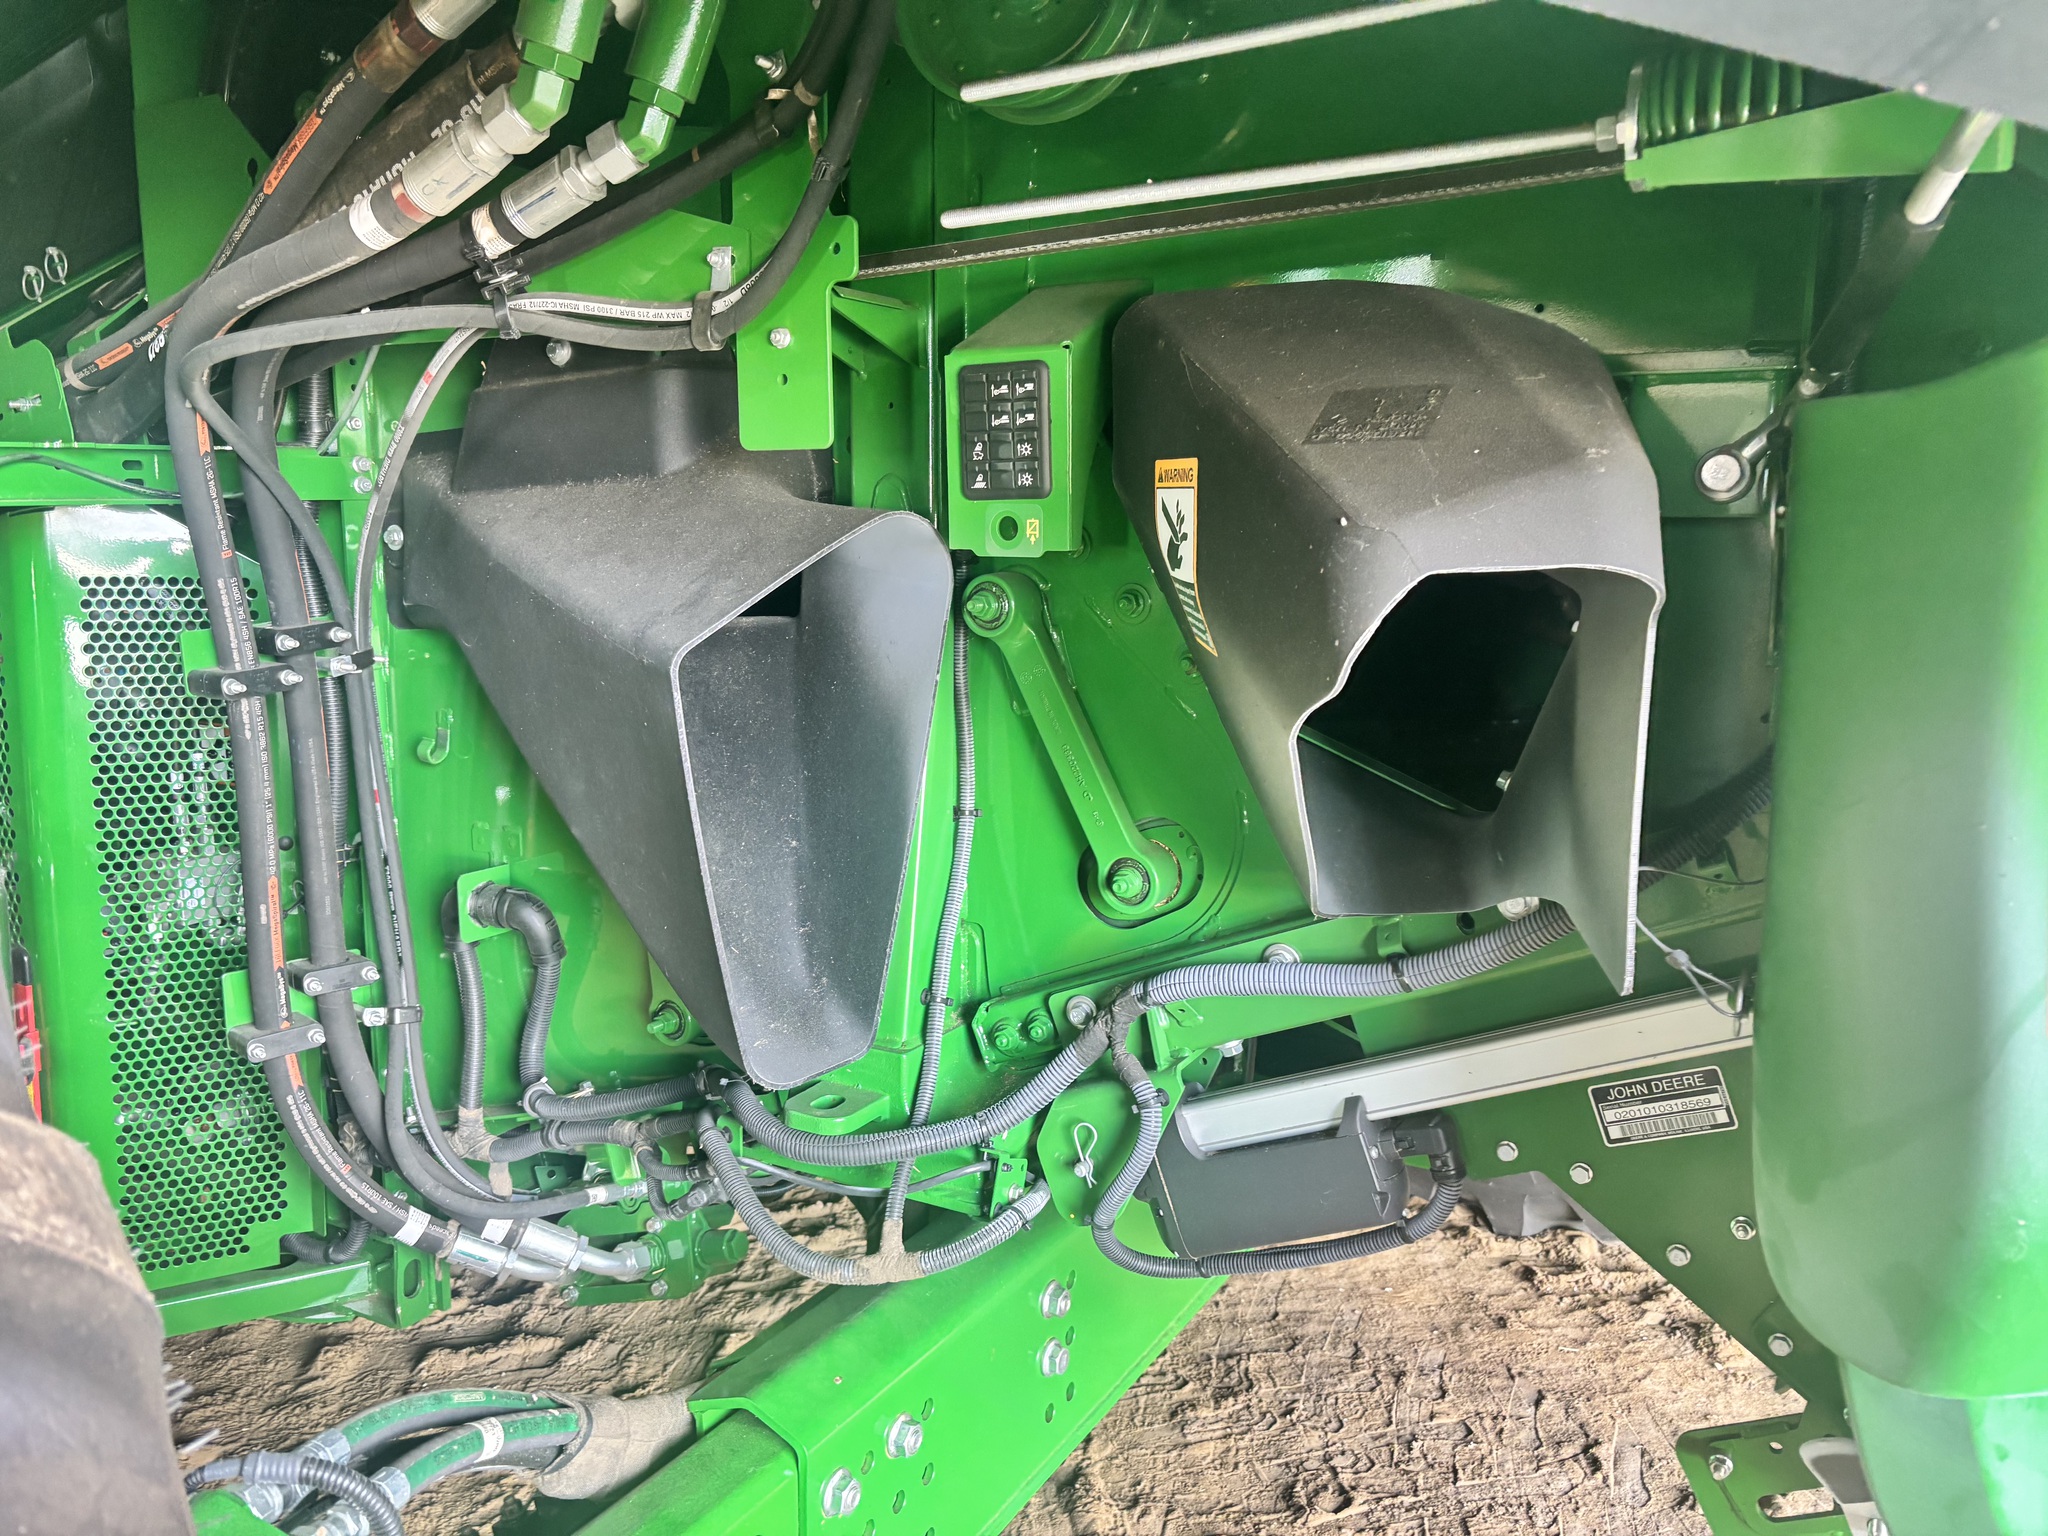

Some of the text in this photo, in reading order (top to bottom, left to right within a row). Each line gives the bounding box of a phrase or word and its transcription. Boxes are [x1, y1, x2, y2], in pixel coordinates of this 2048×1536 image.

[558, 302, 579, 310] MSHA
[583, 304, 595, 312] PSI
[596, 306, 613, 314] 3100
[619, 309, 635, 317] BAR
[637, 310, 650, 318] 215
[203, 455, 214, 479] 2G-11C
[1164, 467, 1193, 482] WARNING
[208, 478, 218, 498] MSHA
[214, 498, 225, 529] Resistant
[221, 528, 231, 551] Flame
[230, 577, 241, 604] 100R15
[236, 606, 245, 619] SAE
[241, 625, 249, 639] 4SH
[256, 716, 264, 730] R15
[1607, 1074, 1706, 1101] JOHN DEERE
[1614, 1098, 1711, 1120] 0201010318569
[295, 1090, 345, 1168] Flame Resistant MSHA 2G-11C
[359, 1182, 381, 1201] 100R15
[380, 1197, 393, 1208] SAE
